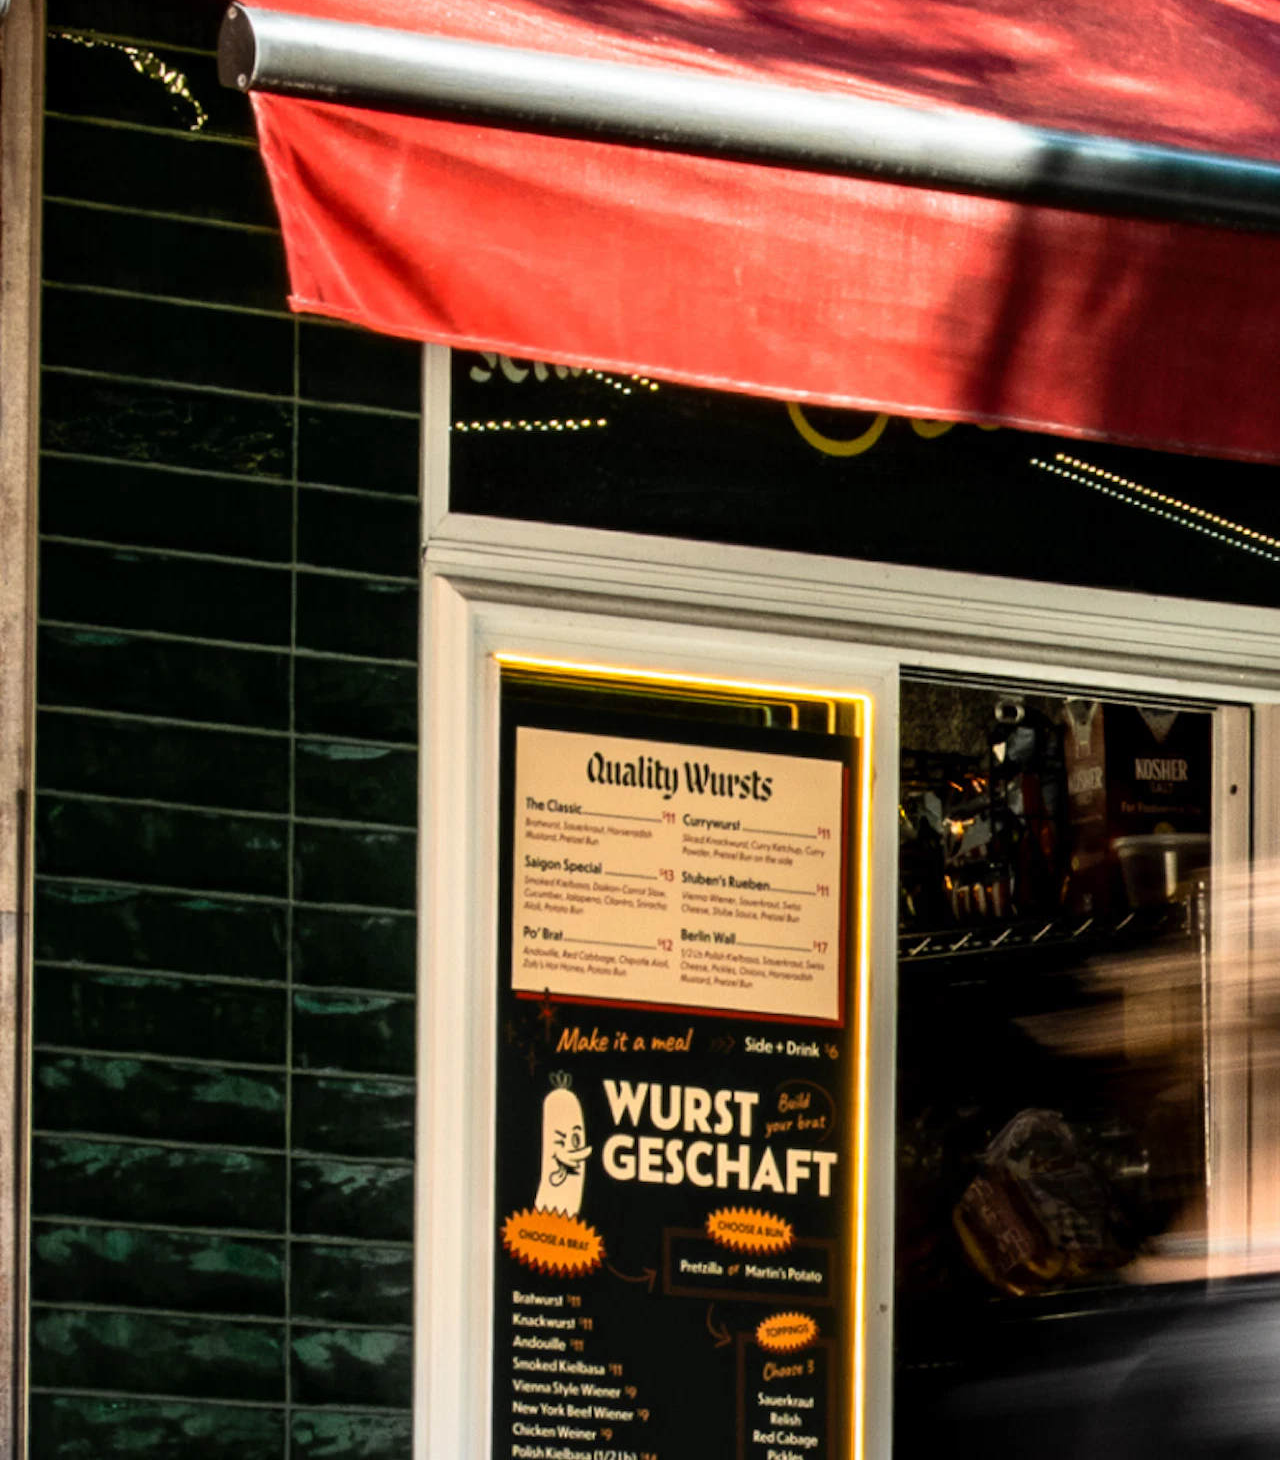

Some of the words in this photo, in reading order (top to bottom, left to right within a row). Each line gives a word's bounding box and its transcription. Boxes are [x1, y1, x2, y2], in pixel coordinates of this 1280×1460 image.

[587, 751, 679, 801] Quality
[684, 761, 773, 802] Wursts
[1135, 758, 1188, 782] KOSHER
[526, 797, 545, 811] The
[547, 799, 582, 815] Classic
[682, 813, 741, 831] Currywurst
[525, 854, 562, 872] Saigon
[563, 858, 602, 875] Special
[682, 871, 726, 887] Stuben's
[728, 876, 771, 891] Rueben
[523, 925, 540, 939] Po'
[542, 927, 563, 941] Brat
[680, 928, 711, 943] Berlin
[713, 931, 736, 945] Wall
[555, 1027, 609, 1053] Make
[613, 1030, 627, 1052] it
[632, 1035, 646, 1052] a
[651, 1027, 694, 1052] meal
[744, 1036, 773, 1053] Side
[775, 1042, 784, 1053] +
[786, 1041, 820, 1058] Drink
[825, 1043, 839, 1060] $6
[602, 1079, 760, 1138] WURST
[778, 1092, 811, 1113] Build
[765, 1119, 793, 1138] your
[797, 1114, 826, 1131] brat
[601, 1133, 838, 1198] GESCHAFT
[717, 1220, 756, 1235] CHOOSE
[756, 1225, 765, 1236] A
[765, 1226, 784, 1238] BUN
[519, 1229, 557, 1246] CHOOSE
[558, 1235, 566, 1247] A
[566, 1237, 590, 1251] BRAT
[680, 1259, 723, 1276] Pretzilla
[745, 1264, 787, 1281] Martin's
[788, 1268, 822, 1283] Potato
[512, 1291, 563, 1307] Bratwurst
[512, 1313, 576, 1330] Knackwurst
[766, 1323, 809, 1338] TOPPINGS
[512, 1335, 566, 1351] Andouille
[512, 1356, 558, 1372] Smoked
[559, 1361, 605, 1376] Kielbasa
[763, 1362, 803, 1382] Choose
[512, 1379, 553, 1393] Vienna
[553, 1381, 580, 1397] Style
[580, 1384, 621, 1399] Wiener
[757, 1391, 814, 1409] Sauerkraut
[512, 1401, 538, 1414] New
[540, 1403, 565, 1417] York
[567, 1405, 592, 1419] Beef
[594, 1407, 633, 1421] Wiener
[770, 1412, 801, 1427] Relish
[512, 1422, 556, 1437] Chicken
[753, 1430, 775, 1443] Red
[512, 1444, 544, 1459] Polish
